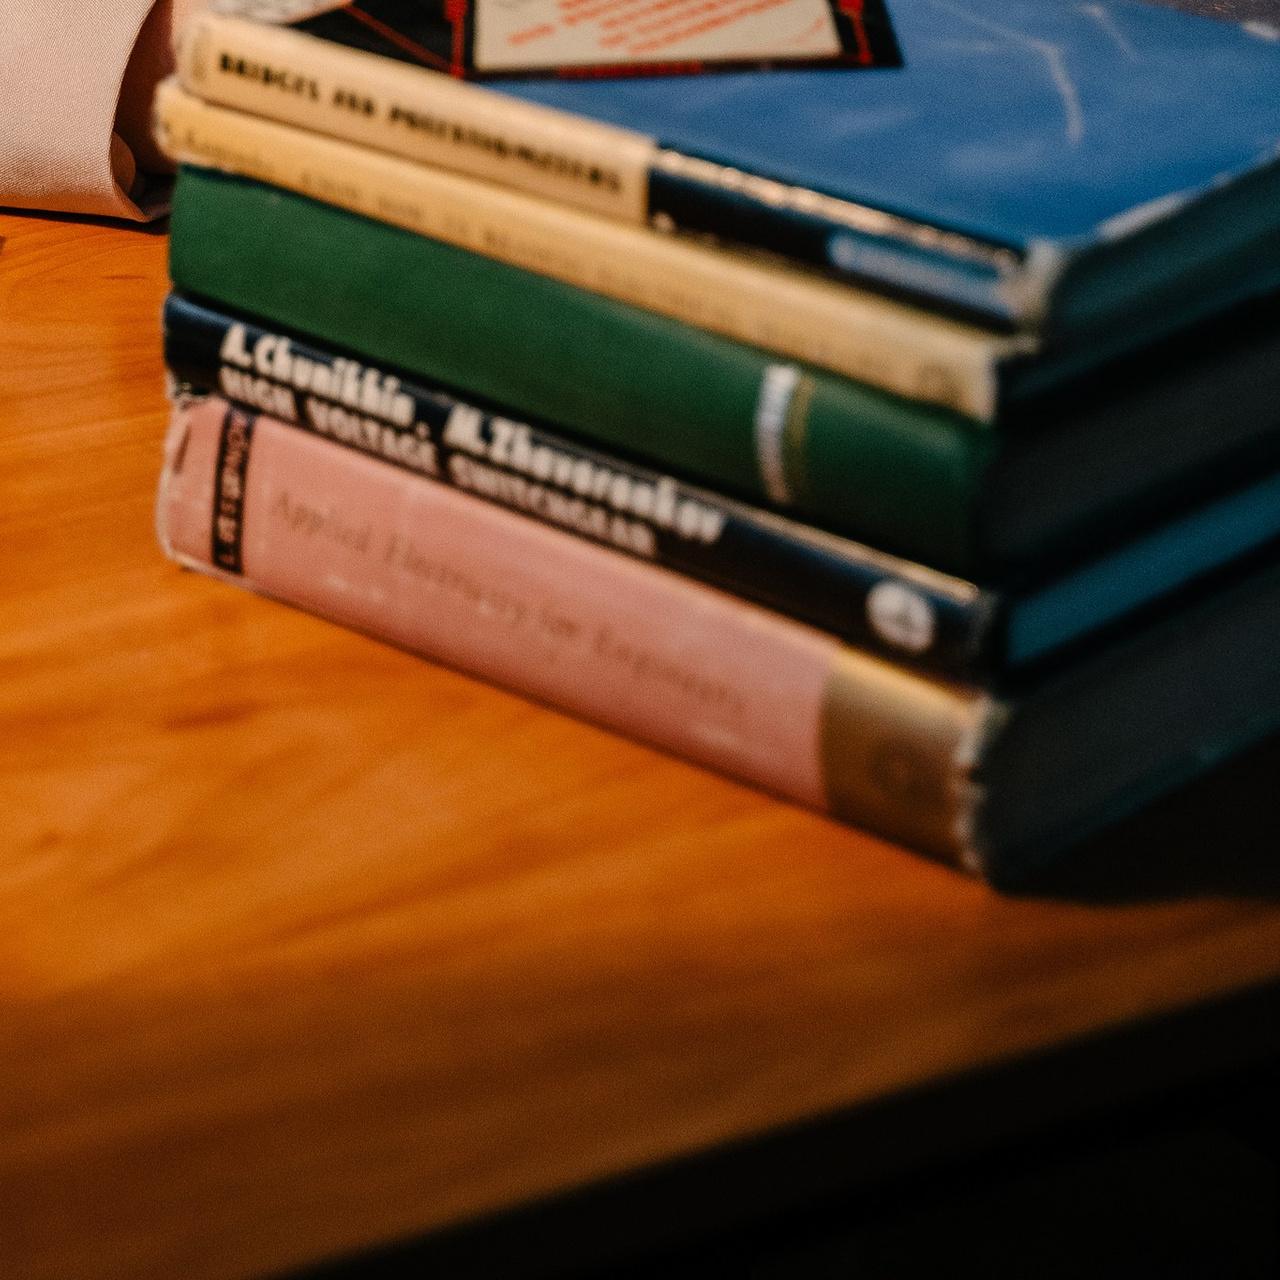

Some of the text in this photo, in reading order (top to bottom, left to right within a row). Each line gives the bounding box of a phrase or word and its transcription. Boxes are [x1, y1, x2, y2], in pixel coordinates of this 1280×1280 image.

[219, 364, 298, 421] HIGH
[304, 394, 440, 478] VOLTAGE
[272, 490, 379, 552] Applied
